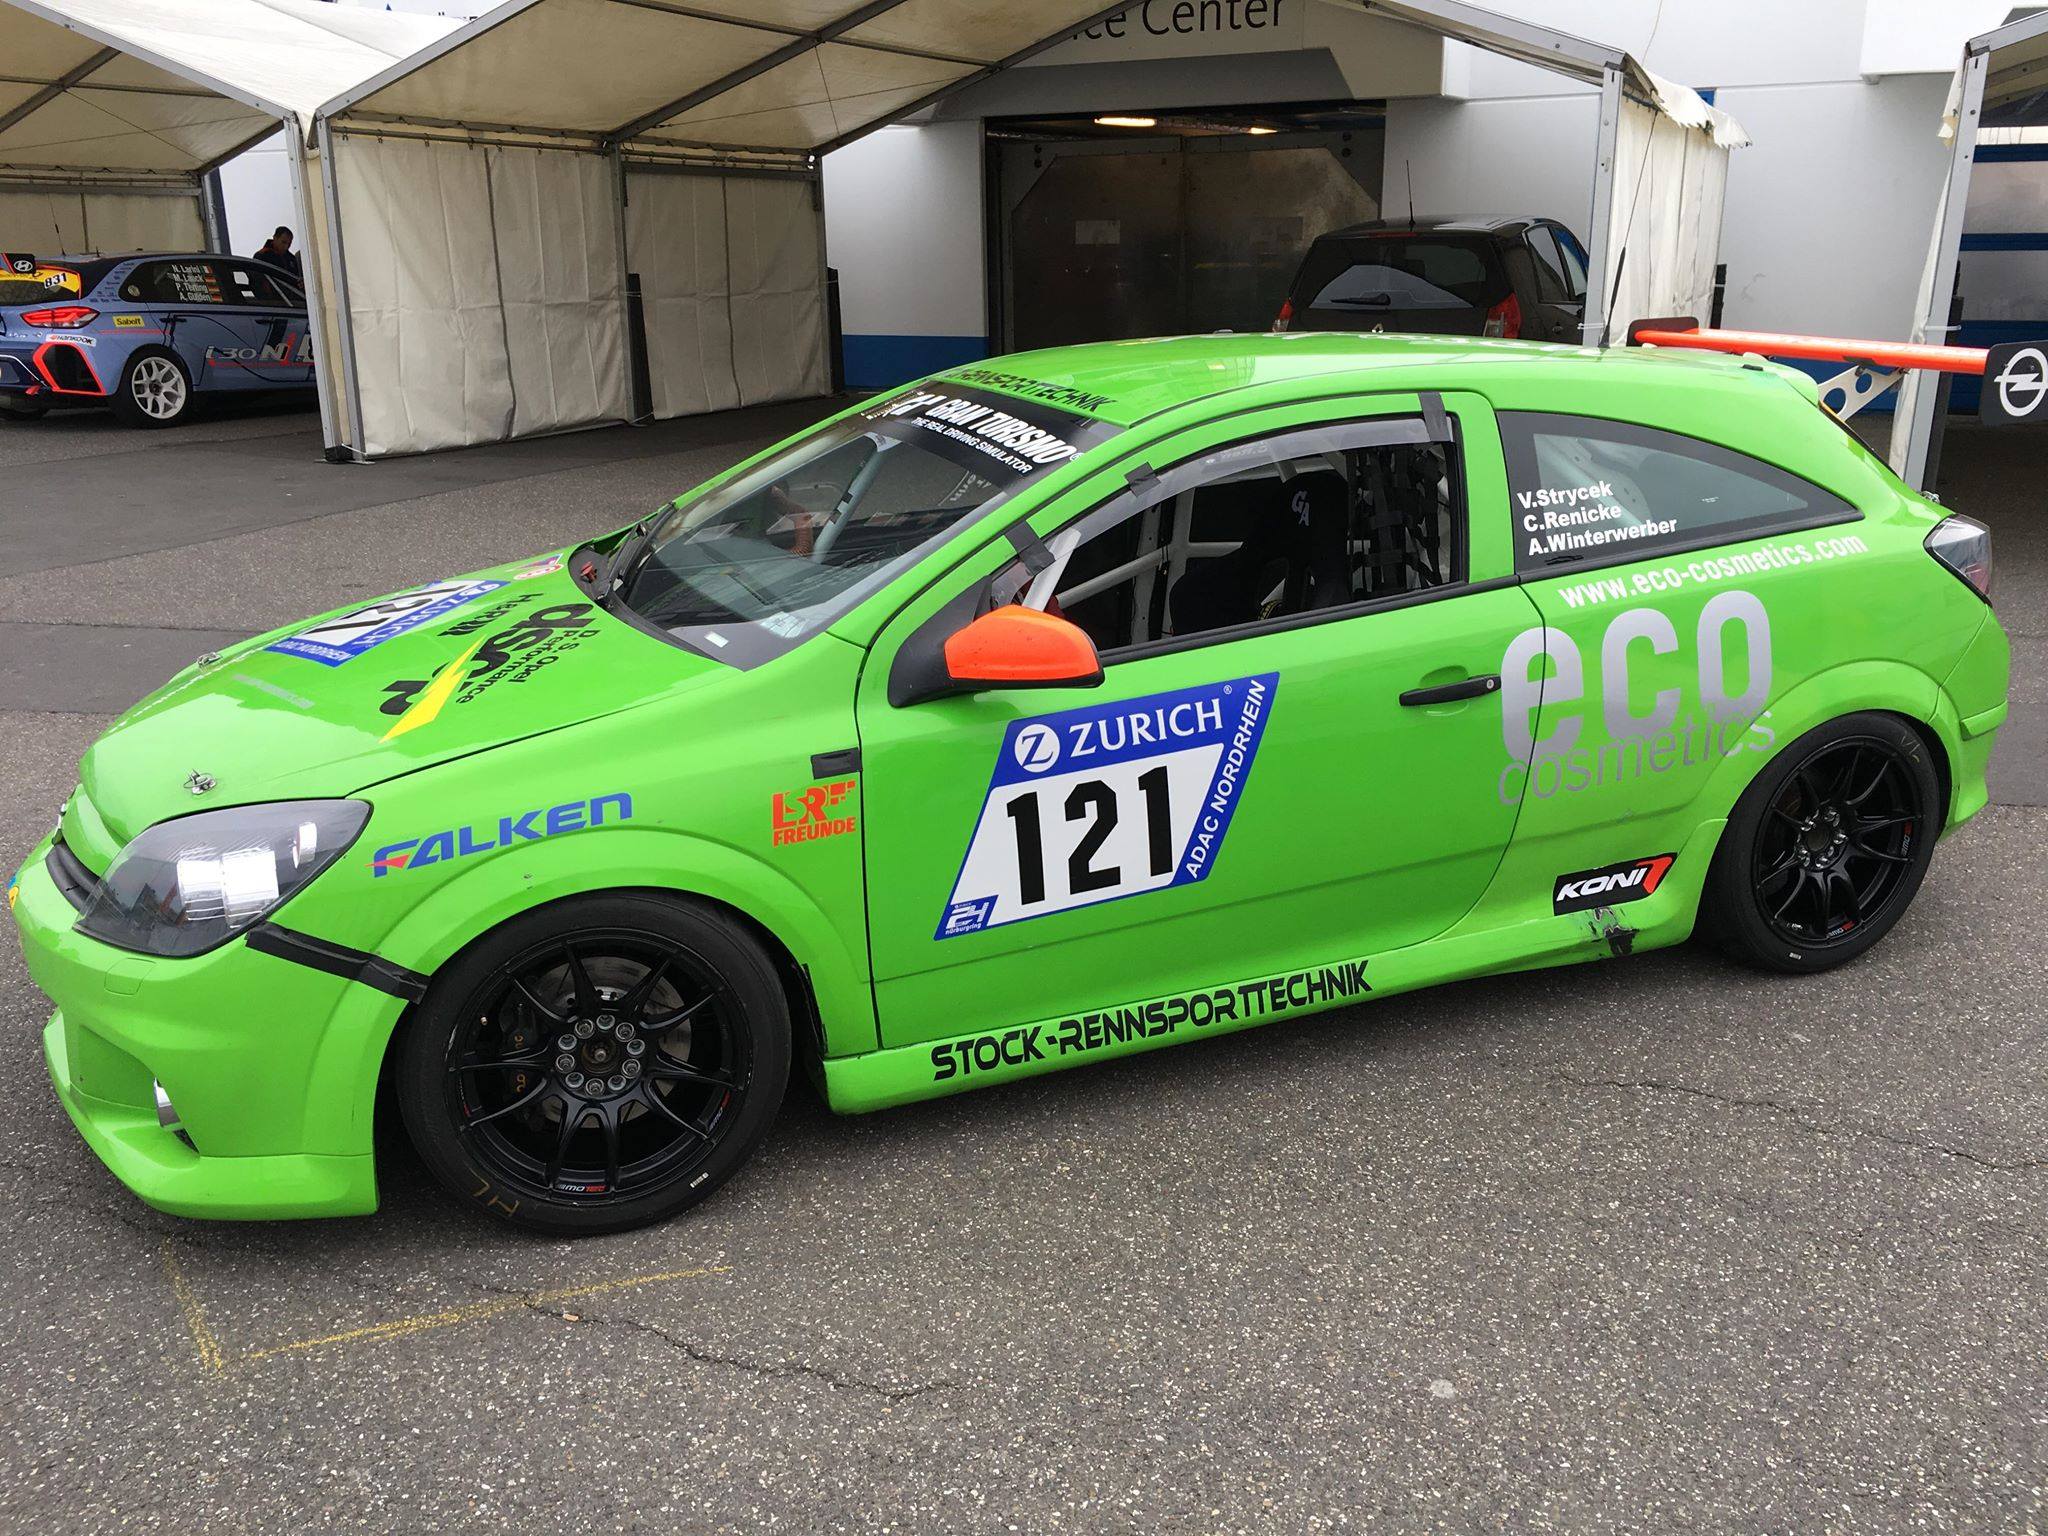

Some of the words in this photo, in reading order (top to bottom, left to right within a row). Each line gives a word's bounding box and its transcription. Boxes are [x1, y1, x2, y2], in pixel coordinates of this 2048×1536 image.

[1142, 0, 1281, 35] Center
[45, 272, 67, 288] 831
[925, 398, 994, 431] GRAN
[967, 411, 1077, 464] TURISMO
[942, 427, 981, 448] DRIVING
[974, 440, 1034, 475] SIMULATOR
[1517, 481, 1614, 509] V.Strycek
[1523, 504, 1622, 532] C.Renicke
[1528, 517, 1678, 556] A.Winterwerber
[1560, 535, 1869, 609] www.eco-cosmetics.com
[455, 629, 578, 704] Performance
[507, 655, 559, 682] Opel
[1500, 590, 1773, 768] eco
[1068, 697, 1224, 759] ZURICH
[1497, 706, 1776, 806] cosmetics
[1185, 815, 1220, 880] ADAC
[1218, 680, 1267, 814] NORDRHEIN
[373, 792, 633, 878] FALKEN
[773, 816, 857, 848] FREUNDE
[1006, 765, 1173, 905] 121
[1556, 867, 1648, 902] KONI
[930, 960, 1375, 1081] STOCK-RENNSPORTTECHNIK
